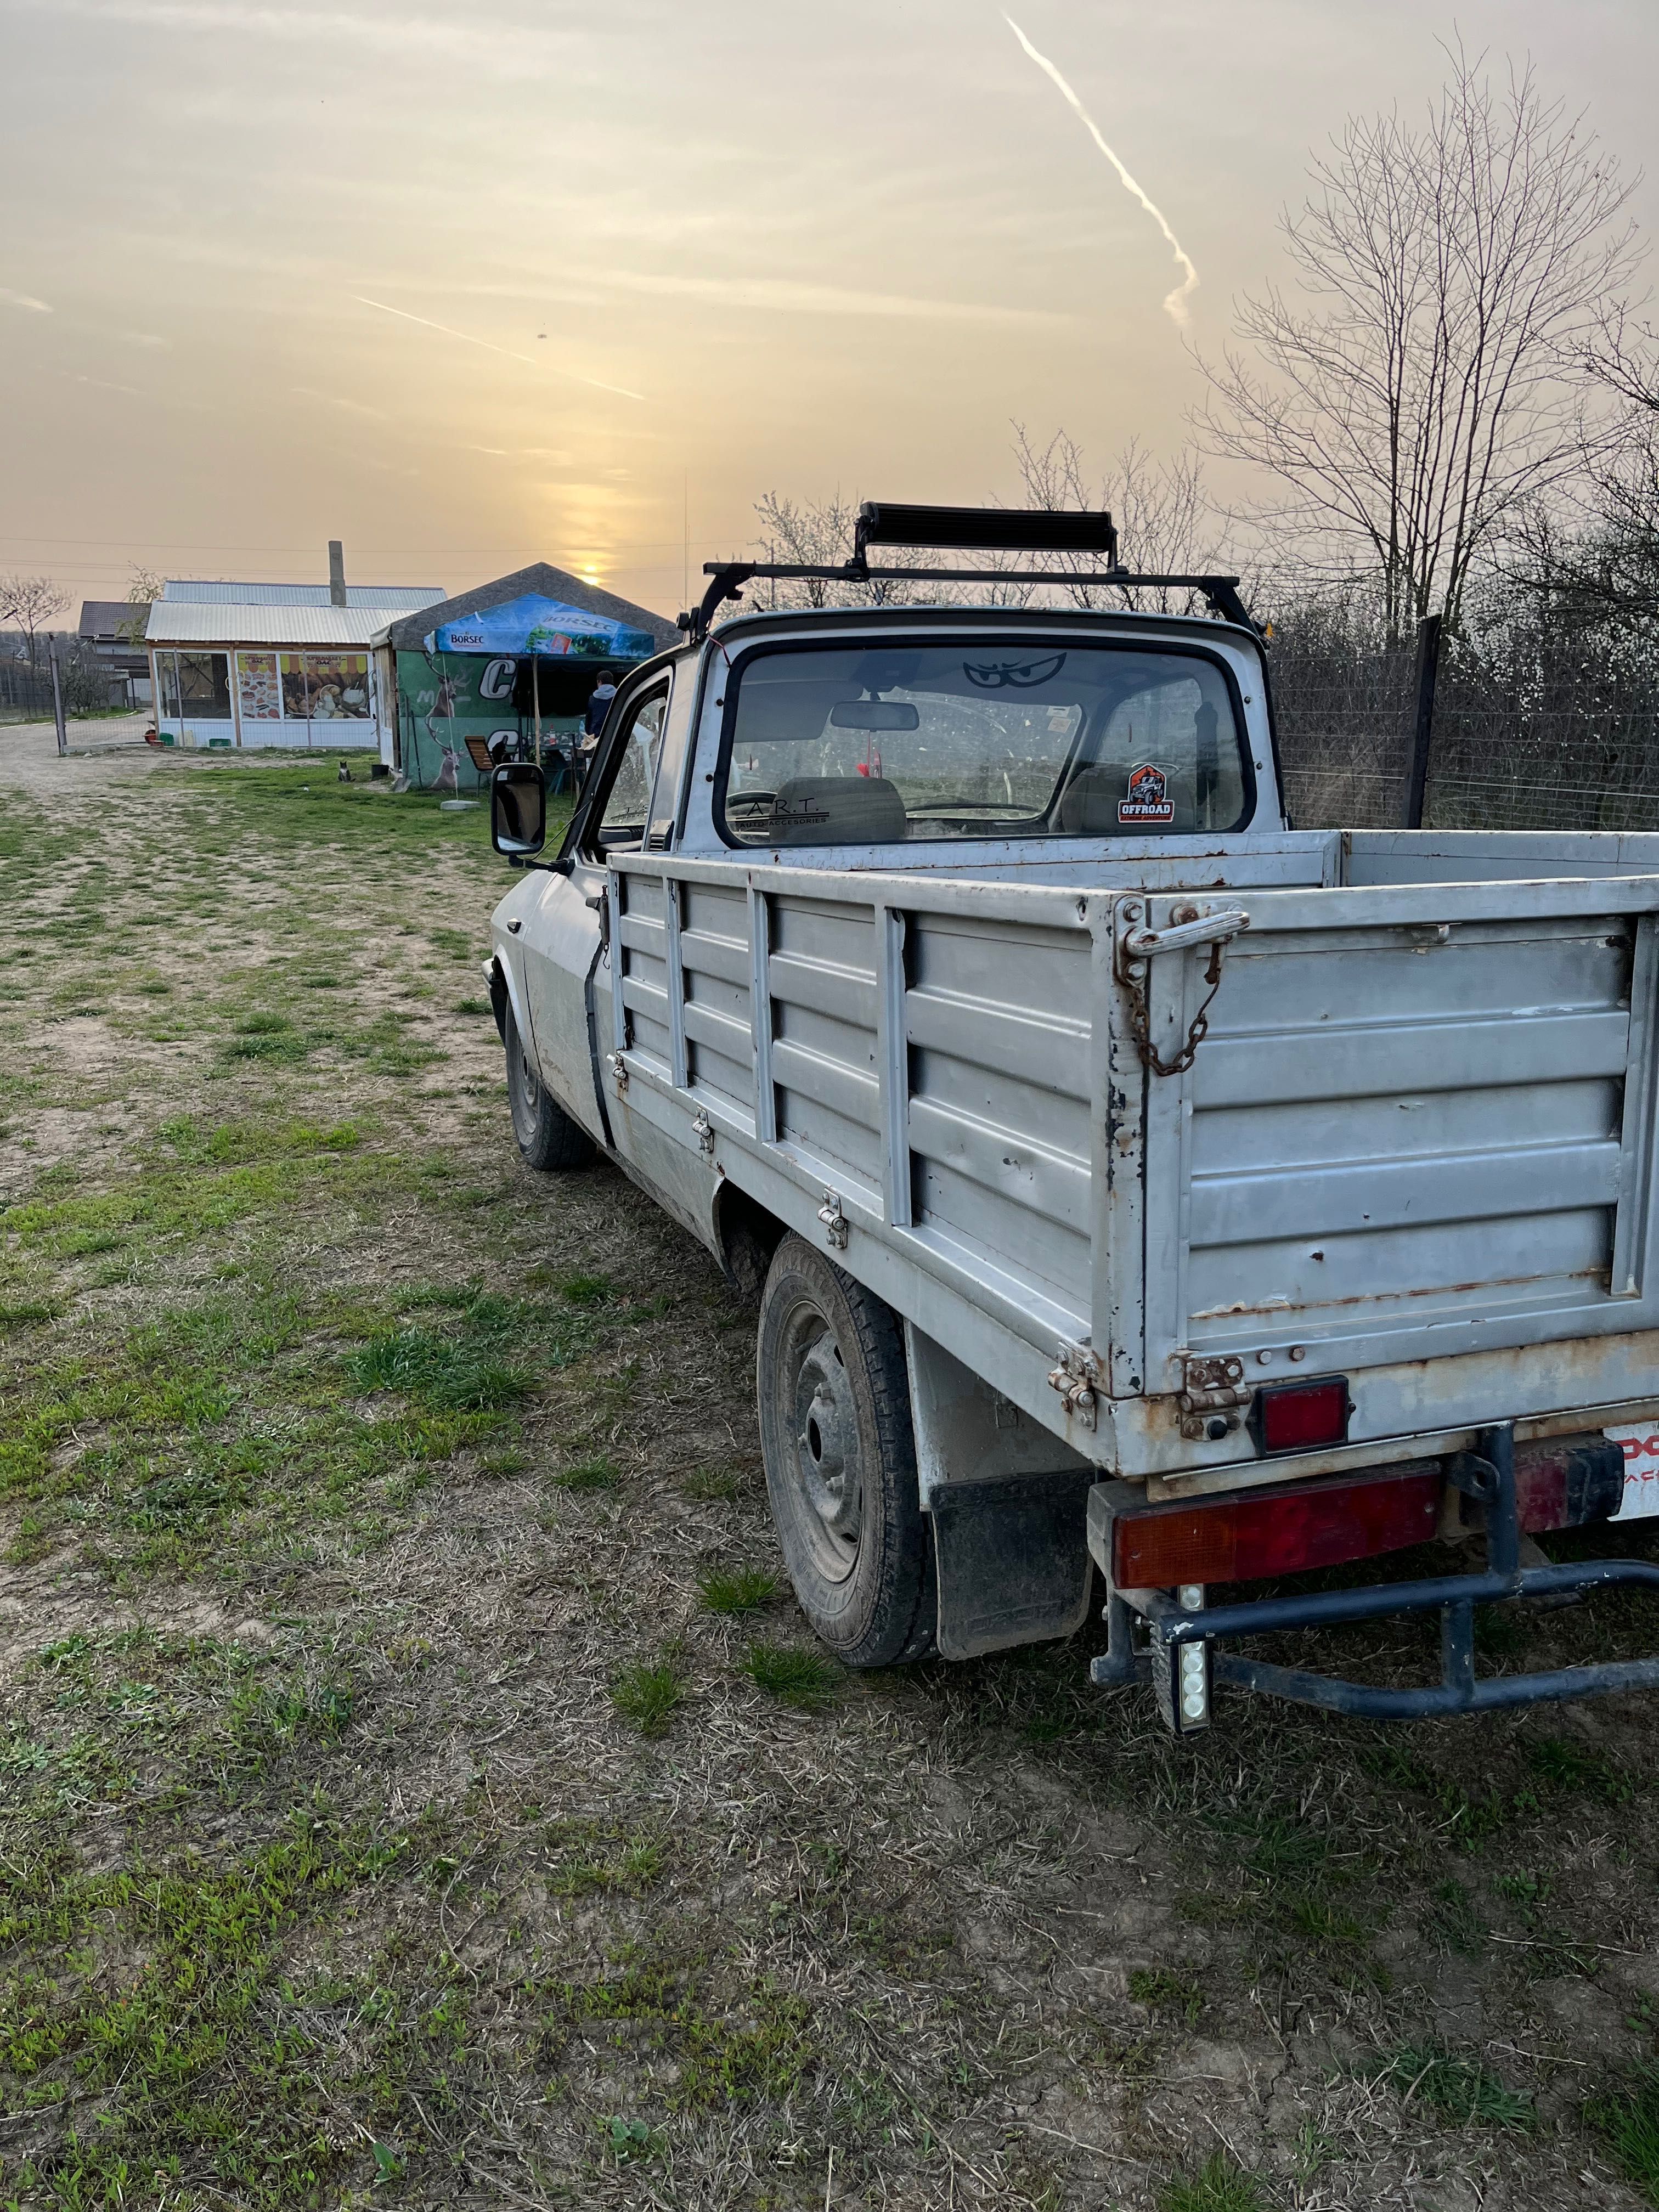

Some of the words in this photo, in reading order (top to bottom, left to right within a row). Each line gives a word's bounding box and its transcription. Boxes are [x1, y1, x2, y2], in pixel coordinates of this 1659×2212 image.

[543, 616, 613, 632] BORSEC
[1122, 804, 1171, 815] OFFROAD
[769, 818, 827, 826] ACCESORIES
